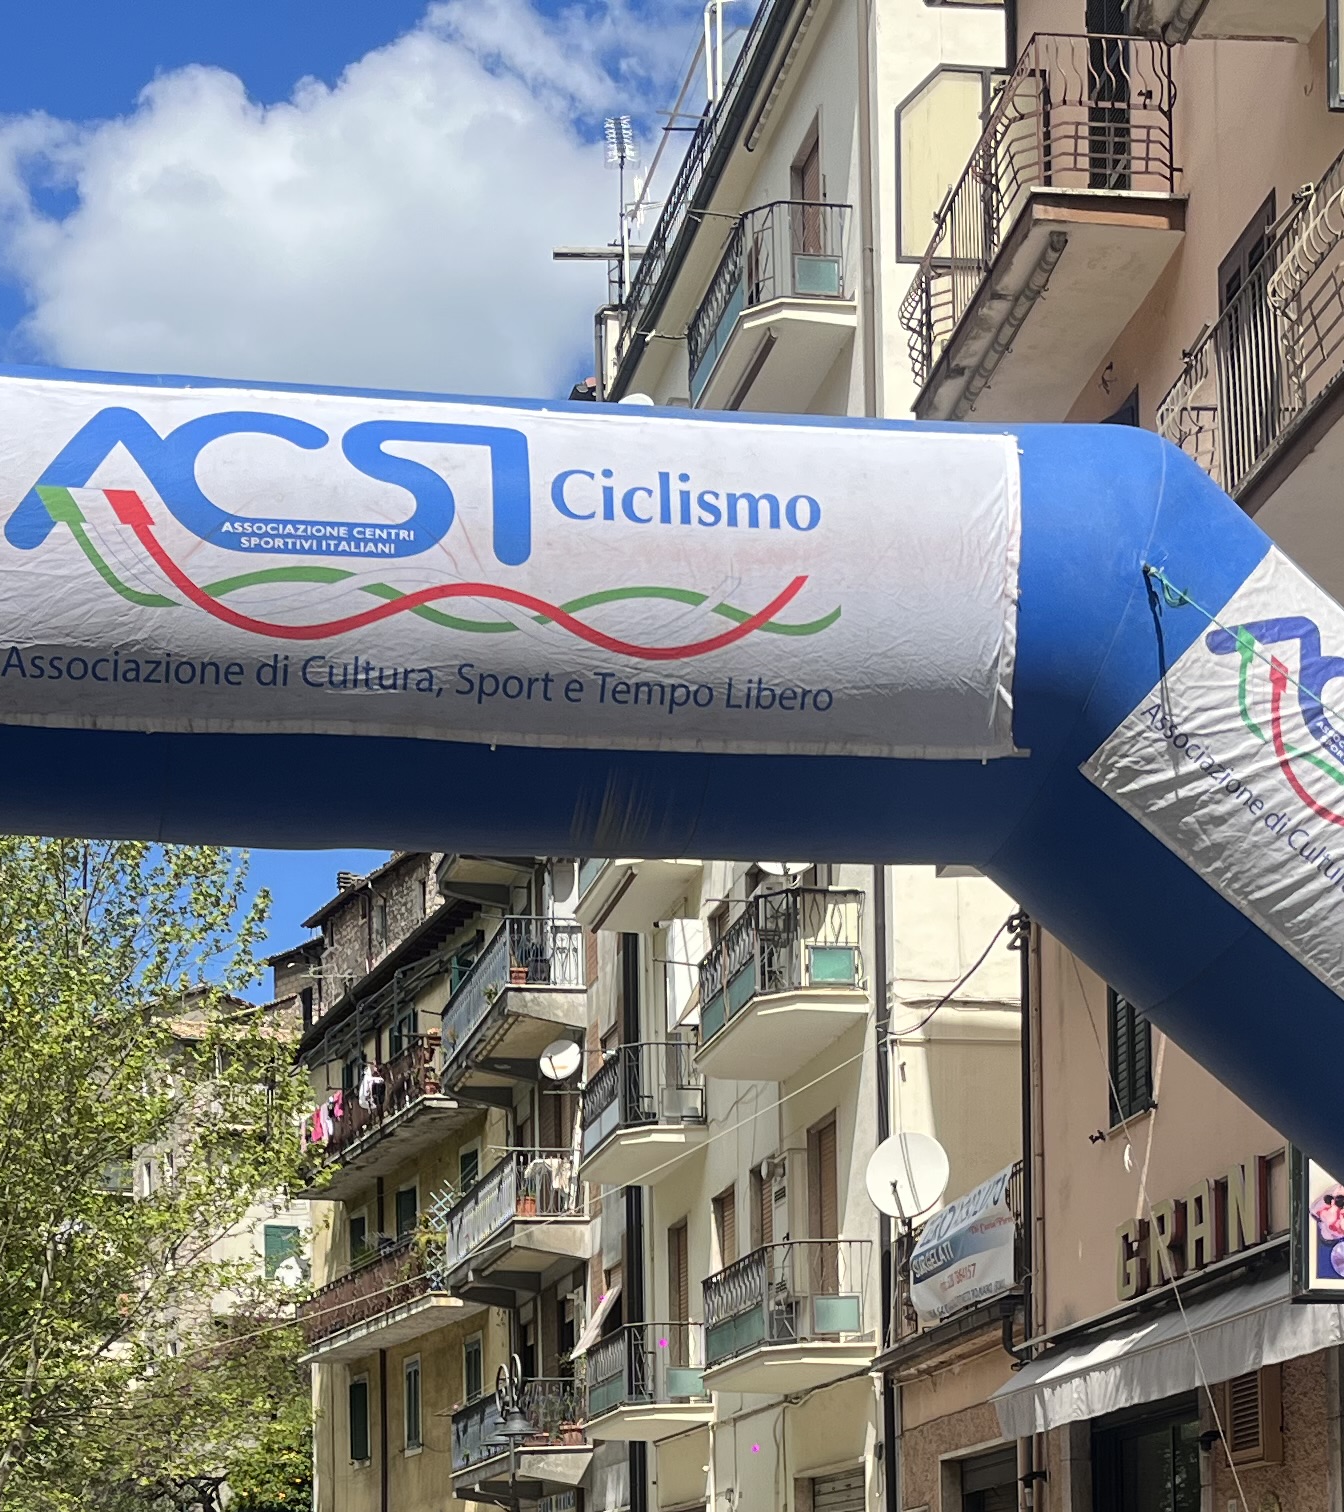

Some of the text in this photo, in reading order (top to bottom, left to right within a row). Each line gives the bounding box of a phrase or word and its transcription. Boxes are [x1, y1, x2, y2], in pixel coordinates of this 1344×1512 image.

[221, 521, 414, 541] ASSOCIAZIONE CENTRI
[551, 468, 822, 532] Ciclismo
[240, 536, 395, 554] SPORTIVI ITALIANI
[1, 646, 834, 717] Associazione di Cultura, Sport e Tempo Libero
[1141, 701, 1265, 816] Associazione
[1263, 808, 1292, 840] di
